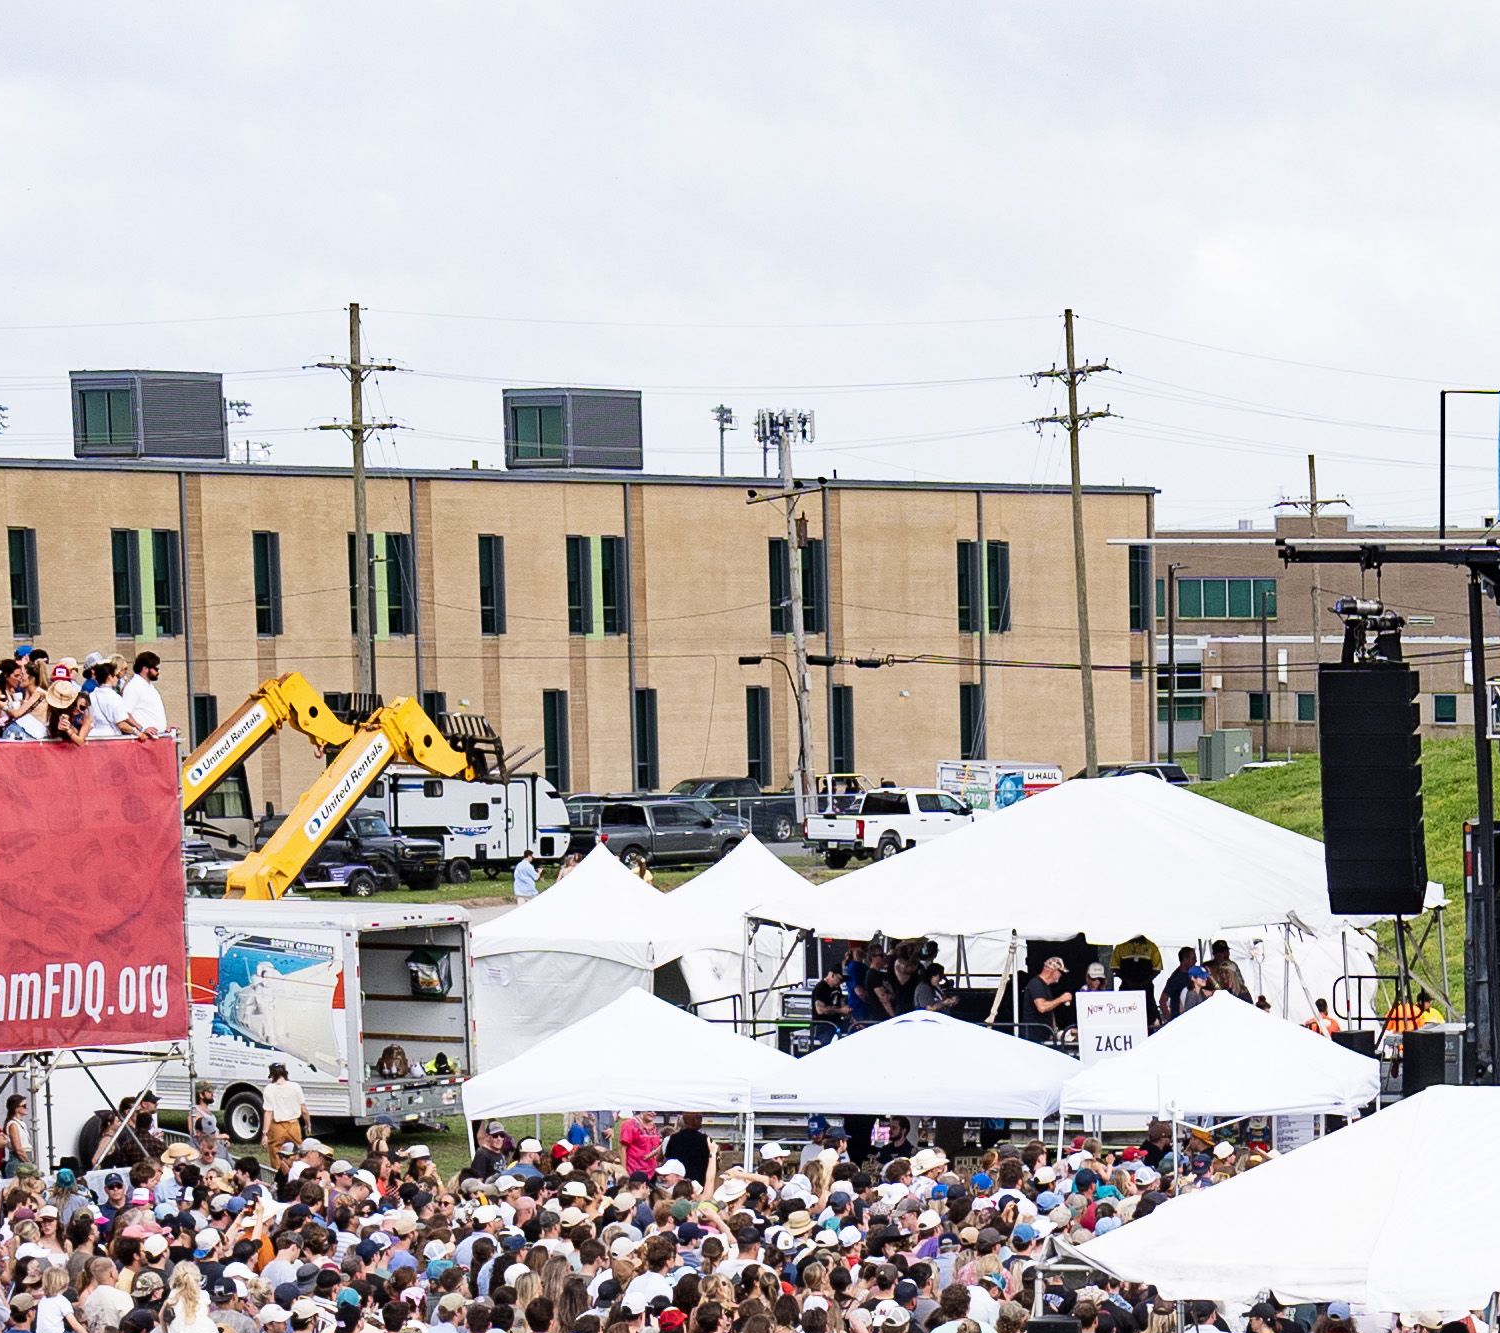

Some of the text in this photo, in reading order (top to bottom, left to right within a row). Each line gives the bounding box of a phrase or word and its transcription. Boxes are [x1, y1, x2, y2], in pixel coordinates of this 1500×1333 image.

[202, 711, 262, 770] United Rentals
[320, 741, 383, 820] United Rentals
[1095, 1035, 1133, 1052] ZACH
